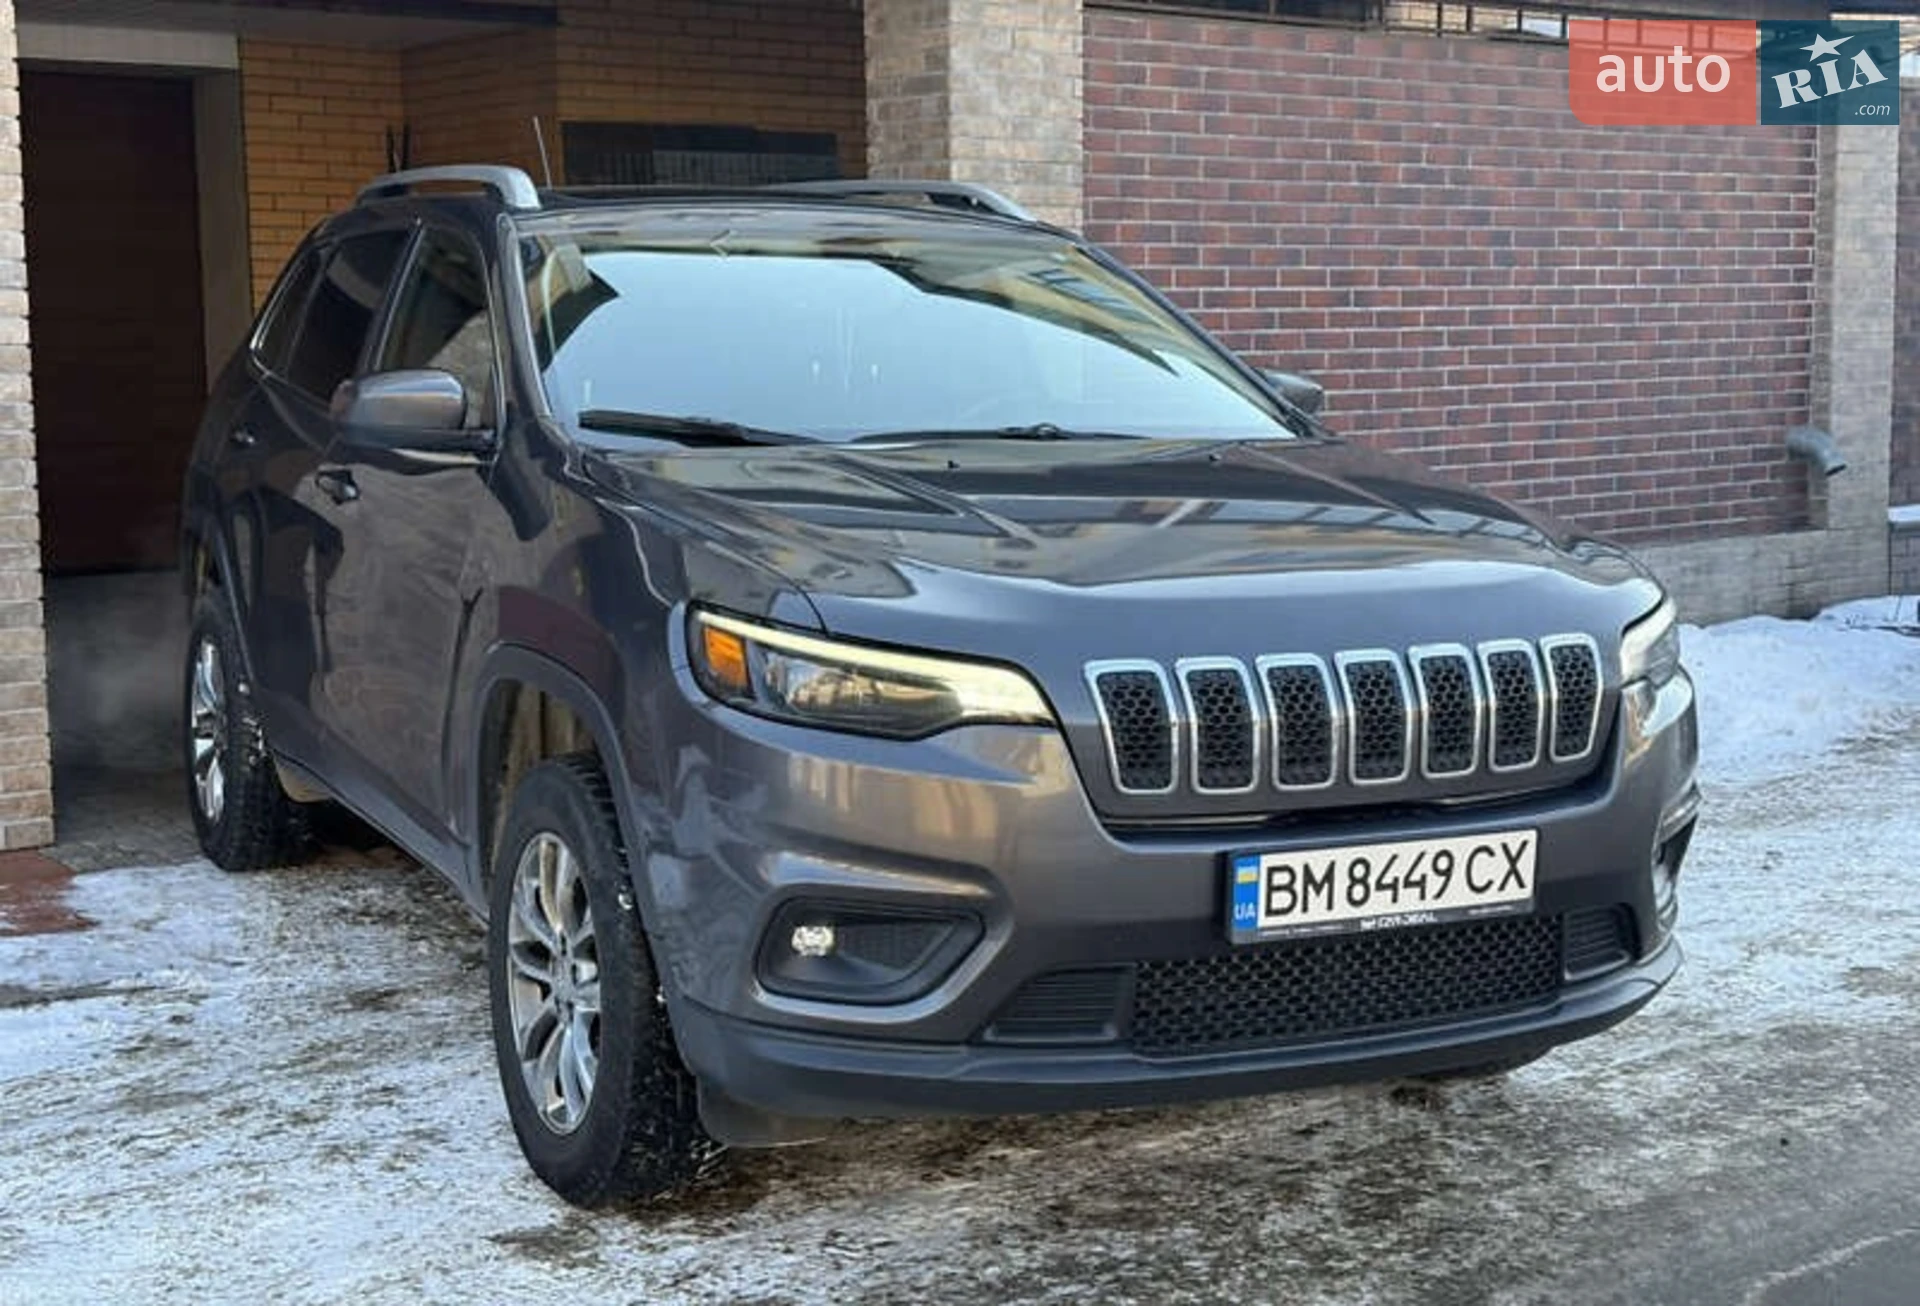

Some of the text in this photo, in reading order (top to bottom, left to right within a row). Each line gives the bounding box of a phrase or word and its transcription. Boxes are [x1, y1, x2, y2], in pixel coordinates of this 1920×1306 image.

[1264, 840, 1529, 918] BM 8449 CX
[1234, 902, 1256, 921] UA
